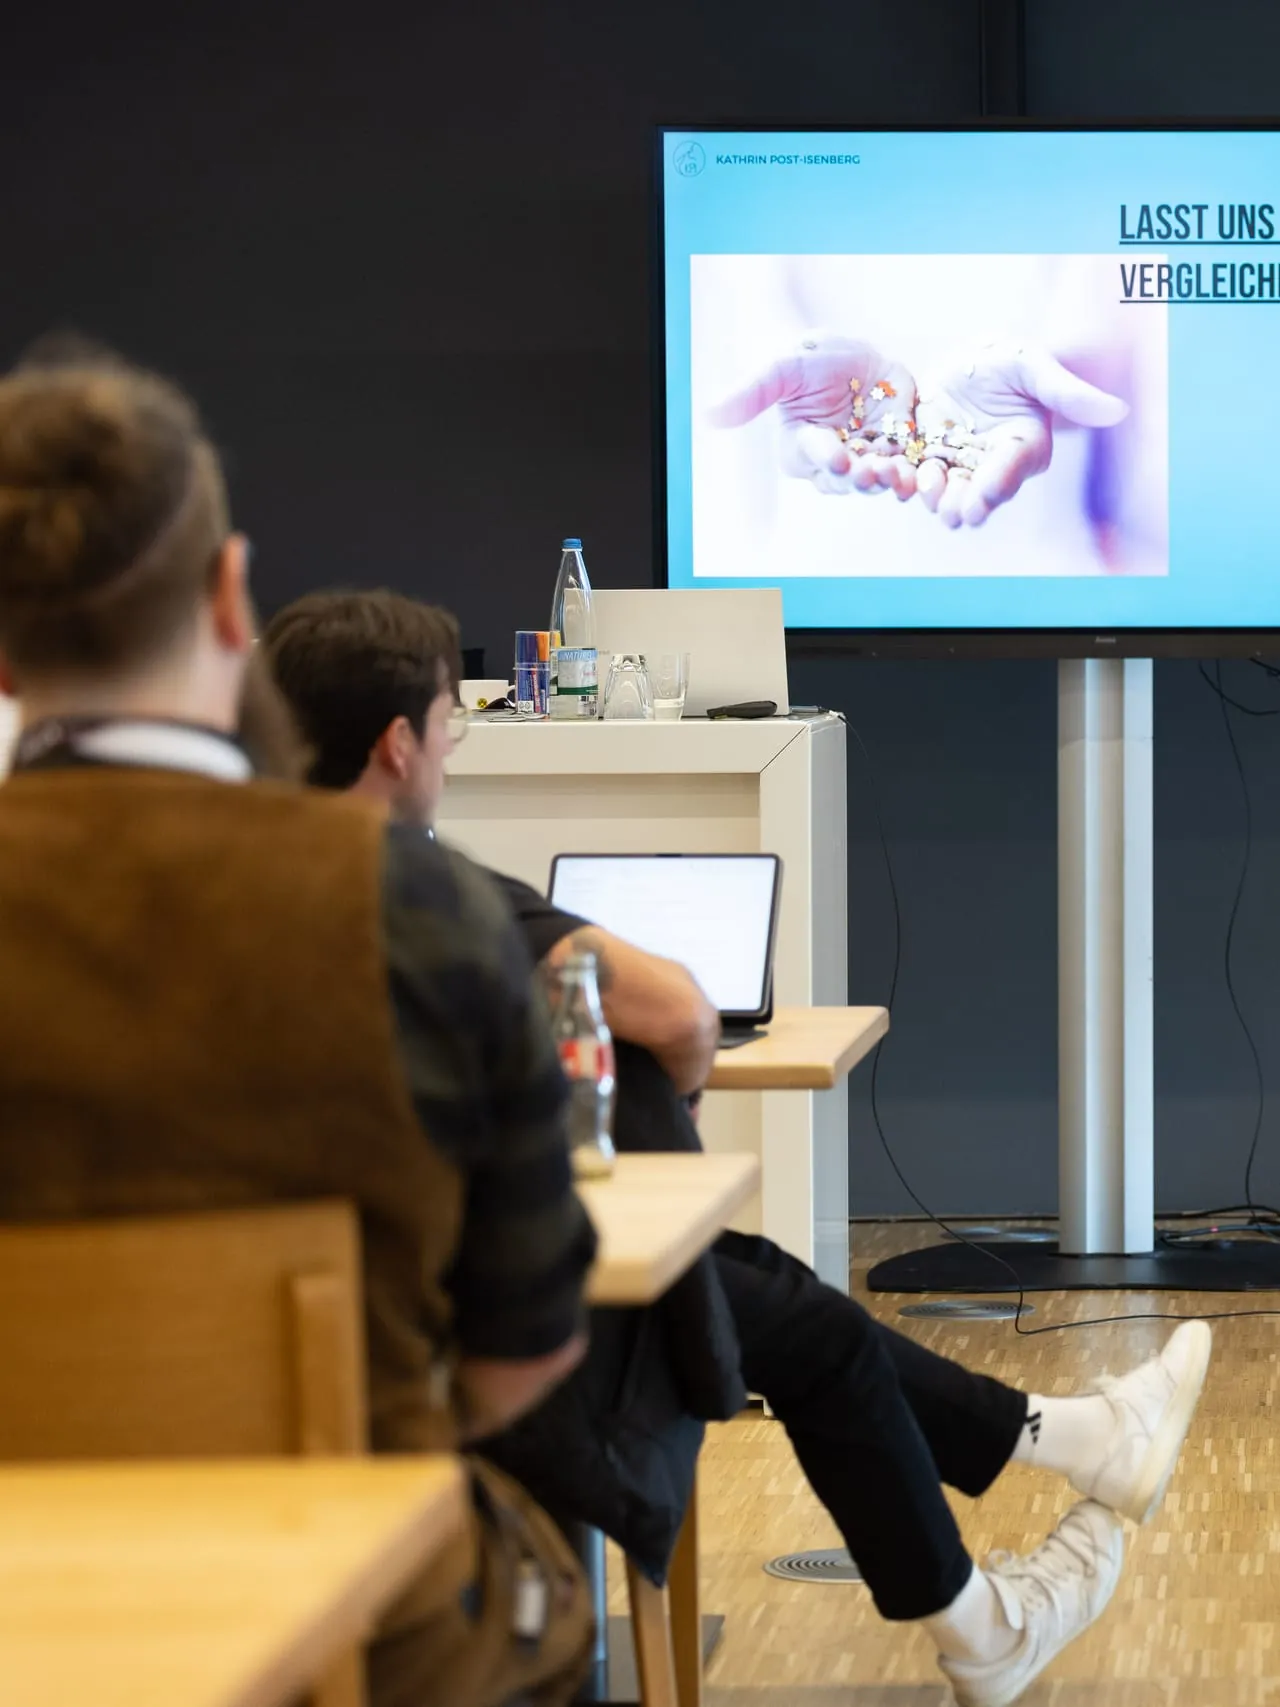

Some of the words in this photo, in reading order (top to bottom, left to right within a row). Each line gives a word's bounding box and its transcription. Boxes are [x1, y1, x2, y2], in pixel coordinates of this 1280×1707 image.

[715, 155, 767, 165] KATHRIN
[770, 155, 860, 165] POST-ISENBERG
[1119, 203, 1209, 241] LASST
[1217, 203, 1275, 241] UNS
